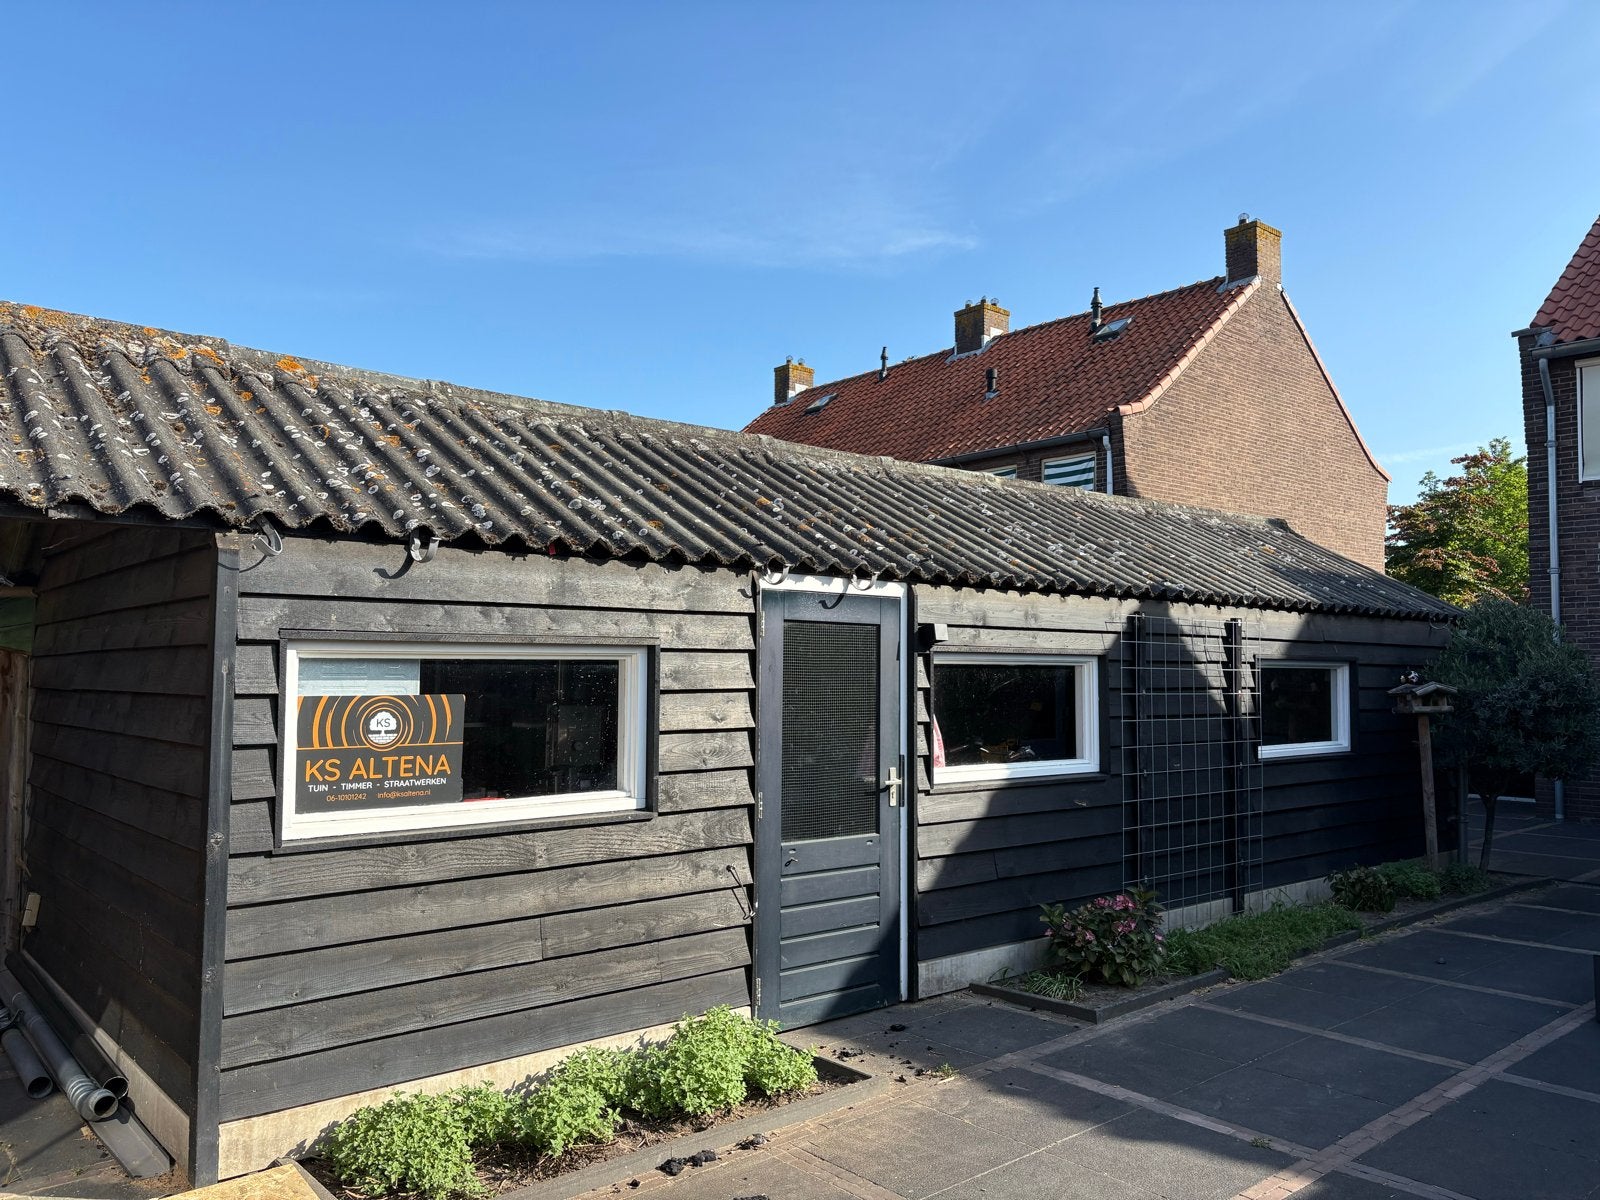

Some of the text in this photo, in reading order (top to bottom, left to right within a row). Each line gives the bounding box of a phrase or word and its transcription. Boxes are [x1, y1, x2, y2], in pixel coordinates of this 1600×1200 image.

[376, 718, 391, 727] KS
[305, 754, 451, 782] KS ALTENA
[308, 784, 329, 792] TUIN
[341, 781, 373, 790] TIMMER
[383, 777, 447, 788] STRAATWERKEN
